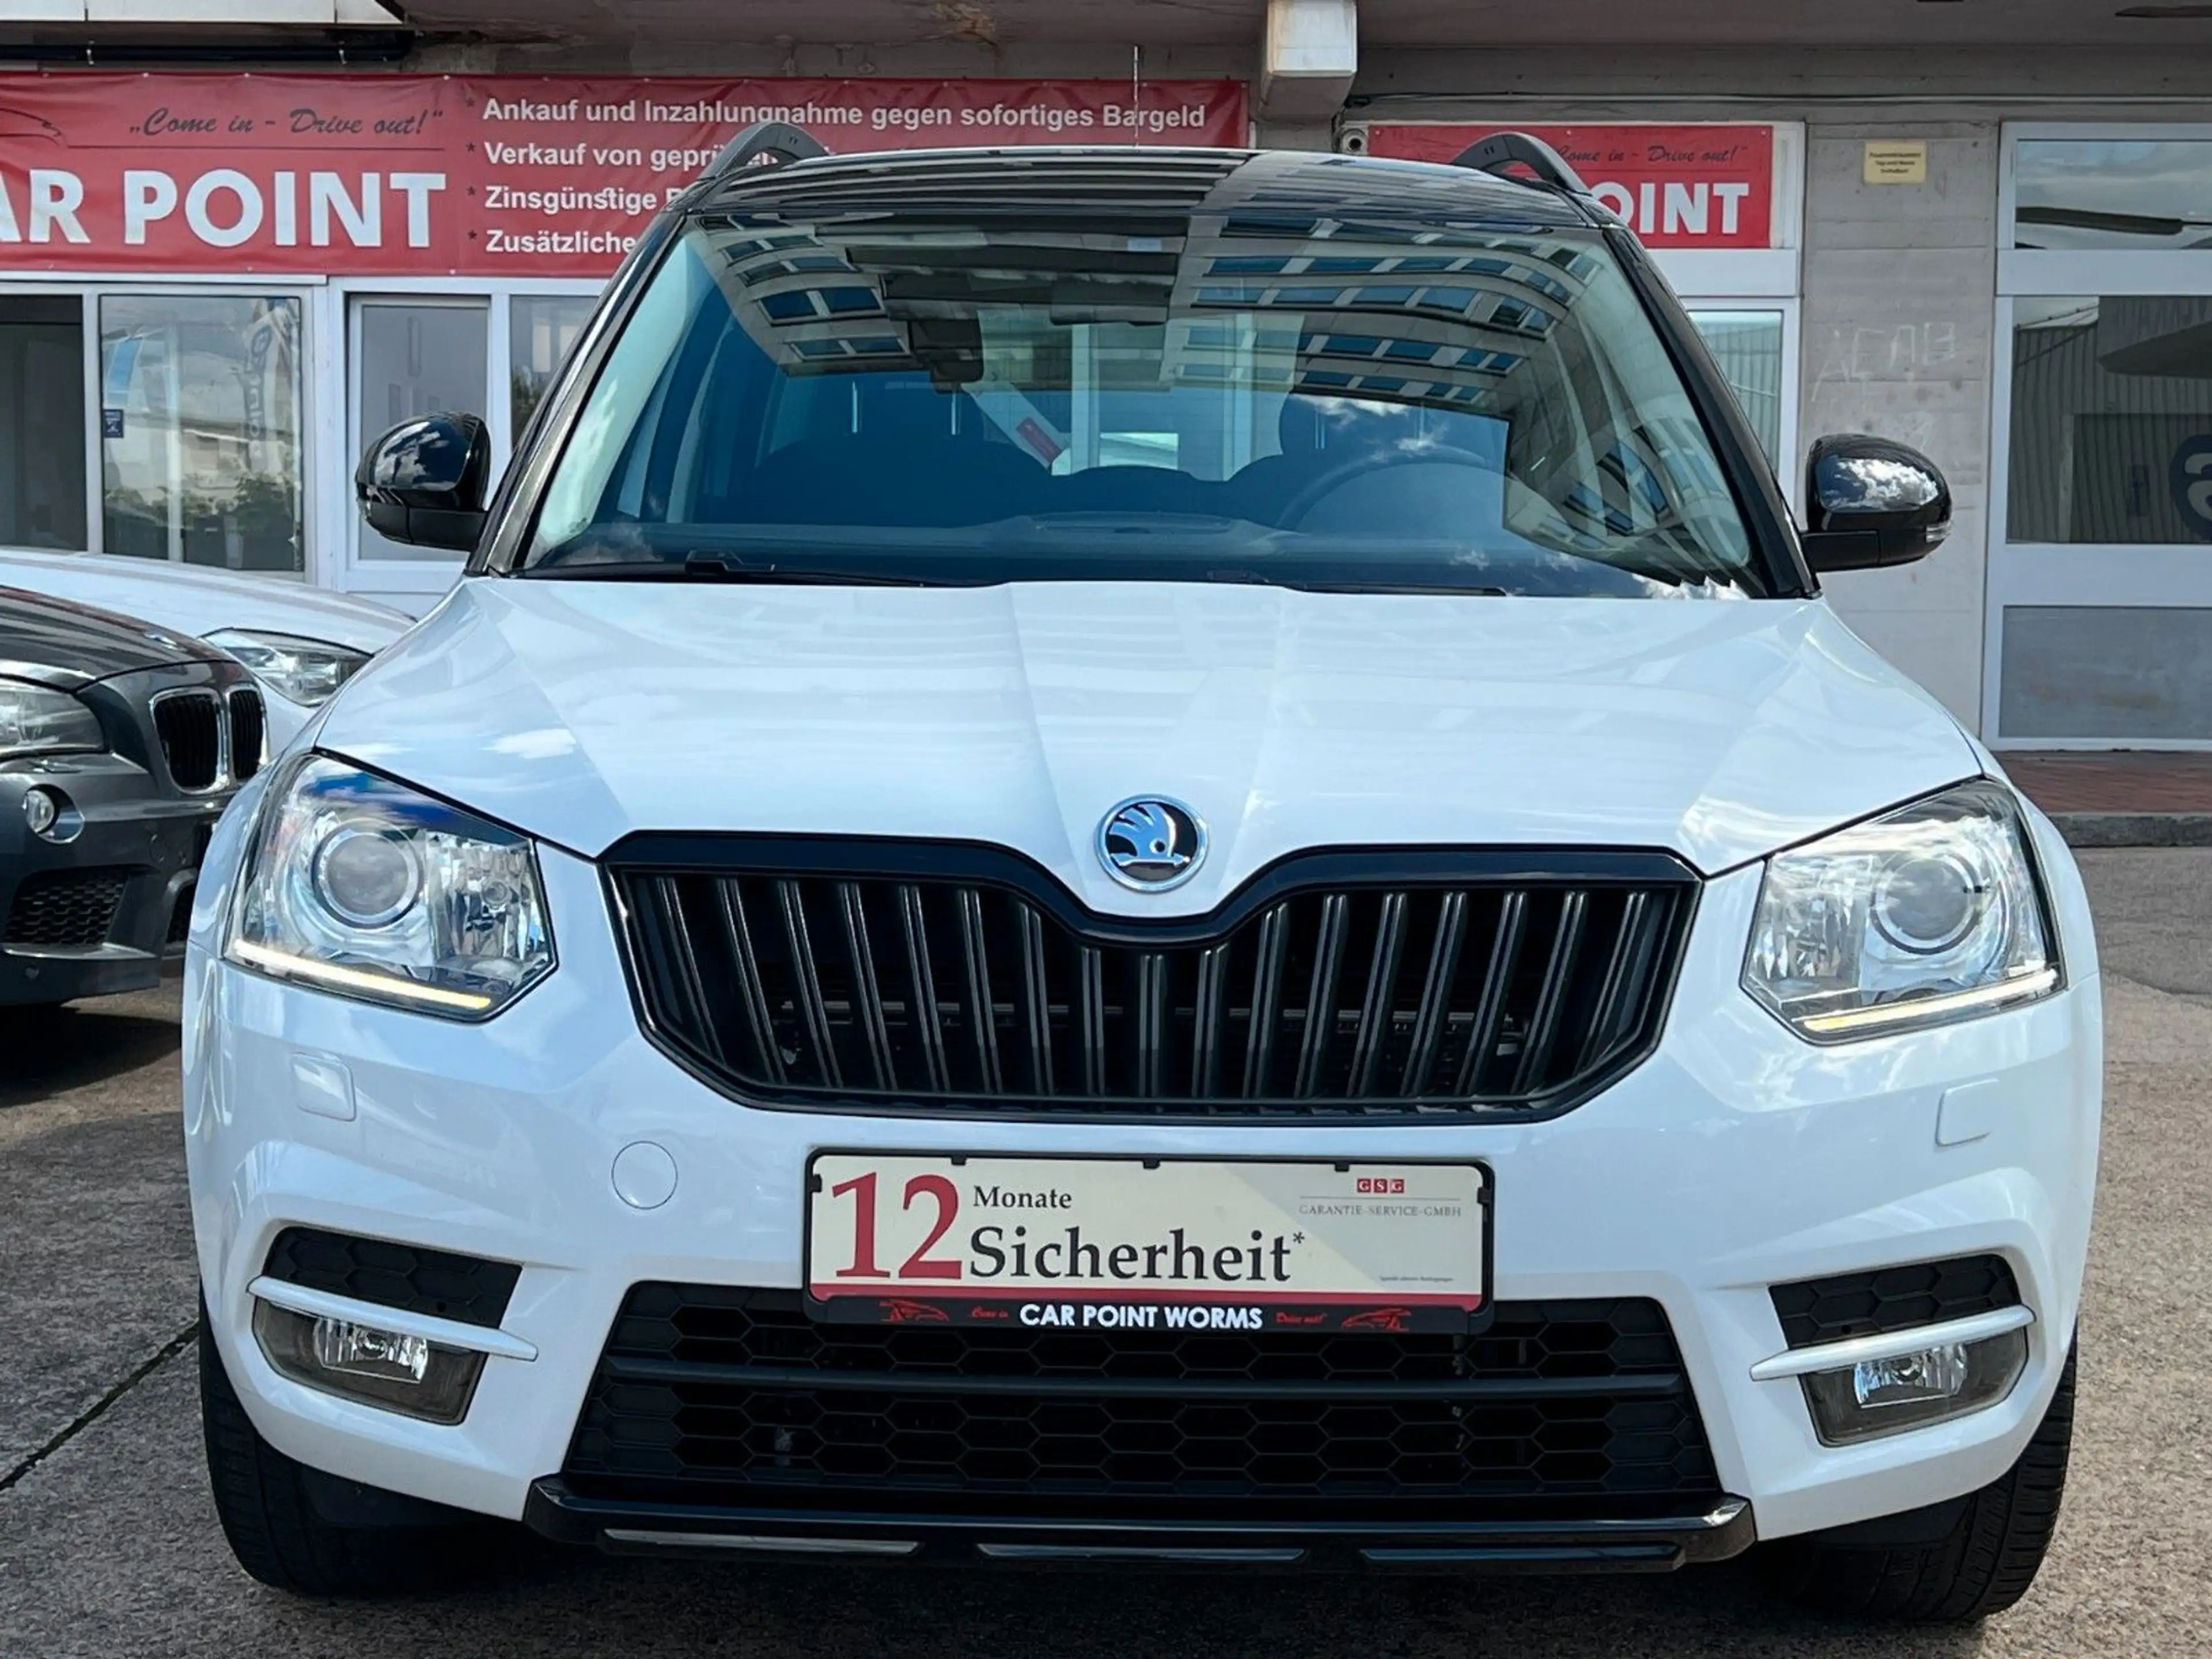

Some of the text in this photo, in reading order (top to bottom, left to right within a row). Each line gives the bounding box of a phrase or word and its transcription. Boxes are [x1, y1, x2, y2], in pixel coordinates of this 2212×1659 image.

[228, 115, 253, 133] in
[289, 107, 363, 134] Drive
[482, 98, 1205, 133] Ankauf und Inzahlungnahme gegen sofortiges Bargeld
[483, 141, 587, 165] Verkauf
[592, 148, 642, 166] von
[1648, 145, 1694, 162] Drive
[123, 168, 446, 248] POINT
[484, 185, 657, 215] Zinsgünstige
[1590, 181, 1749, 234] OINT
[974, 1185, 1073, 1209] Monate
[1357, 1179, 1404, 1193] GSG
[831, 1172, 963, 1280] 12
[1019, 1303, 1075, 1327] CAR
[1082, 1304, 1158, 1328] POINT
[1163, 1305, 1263, 1330] WORMS
